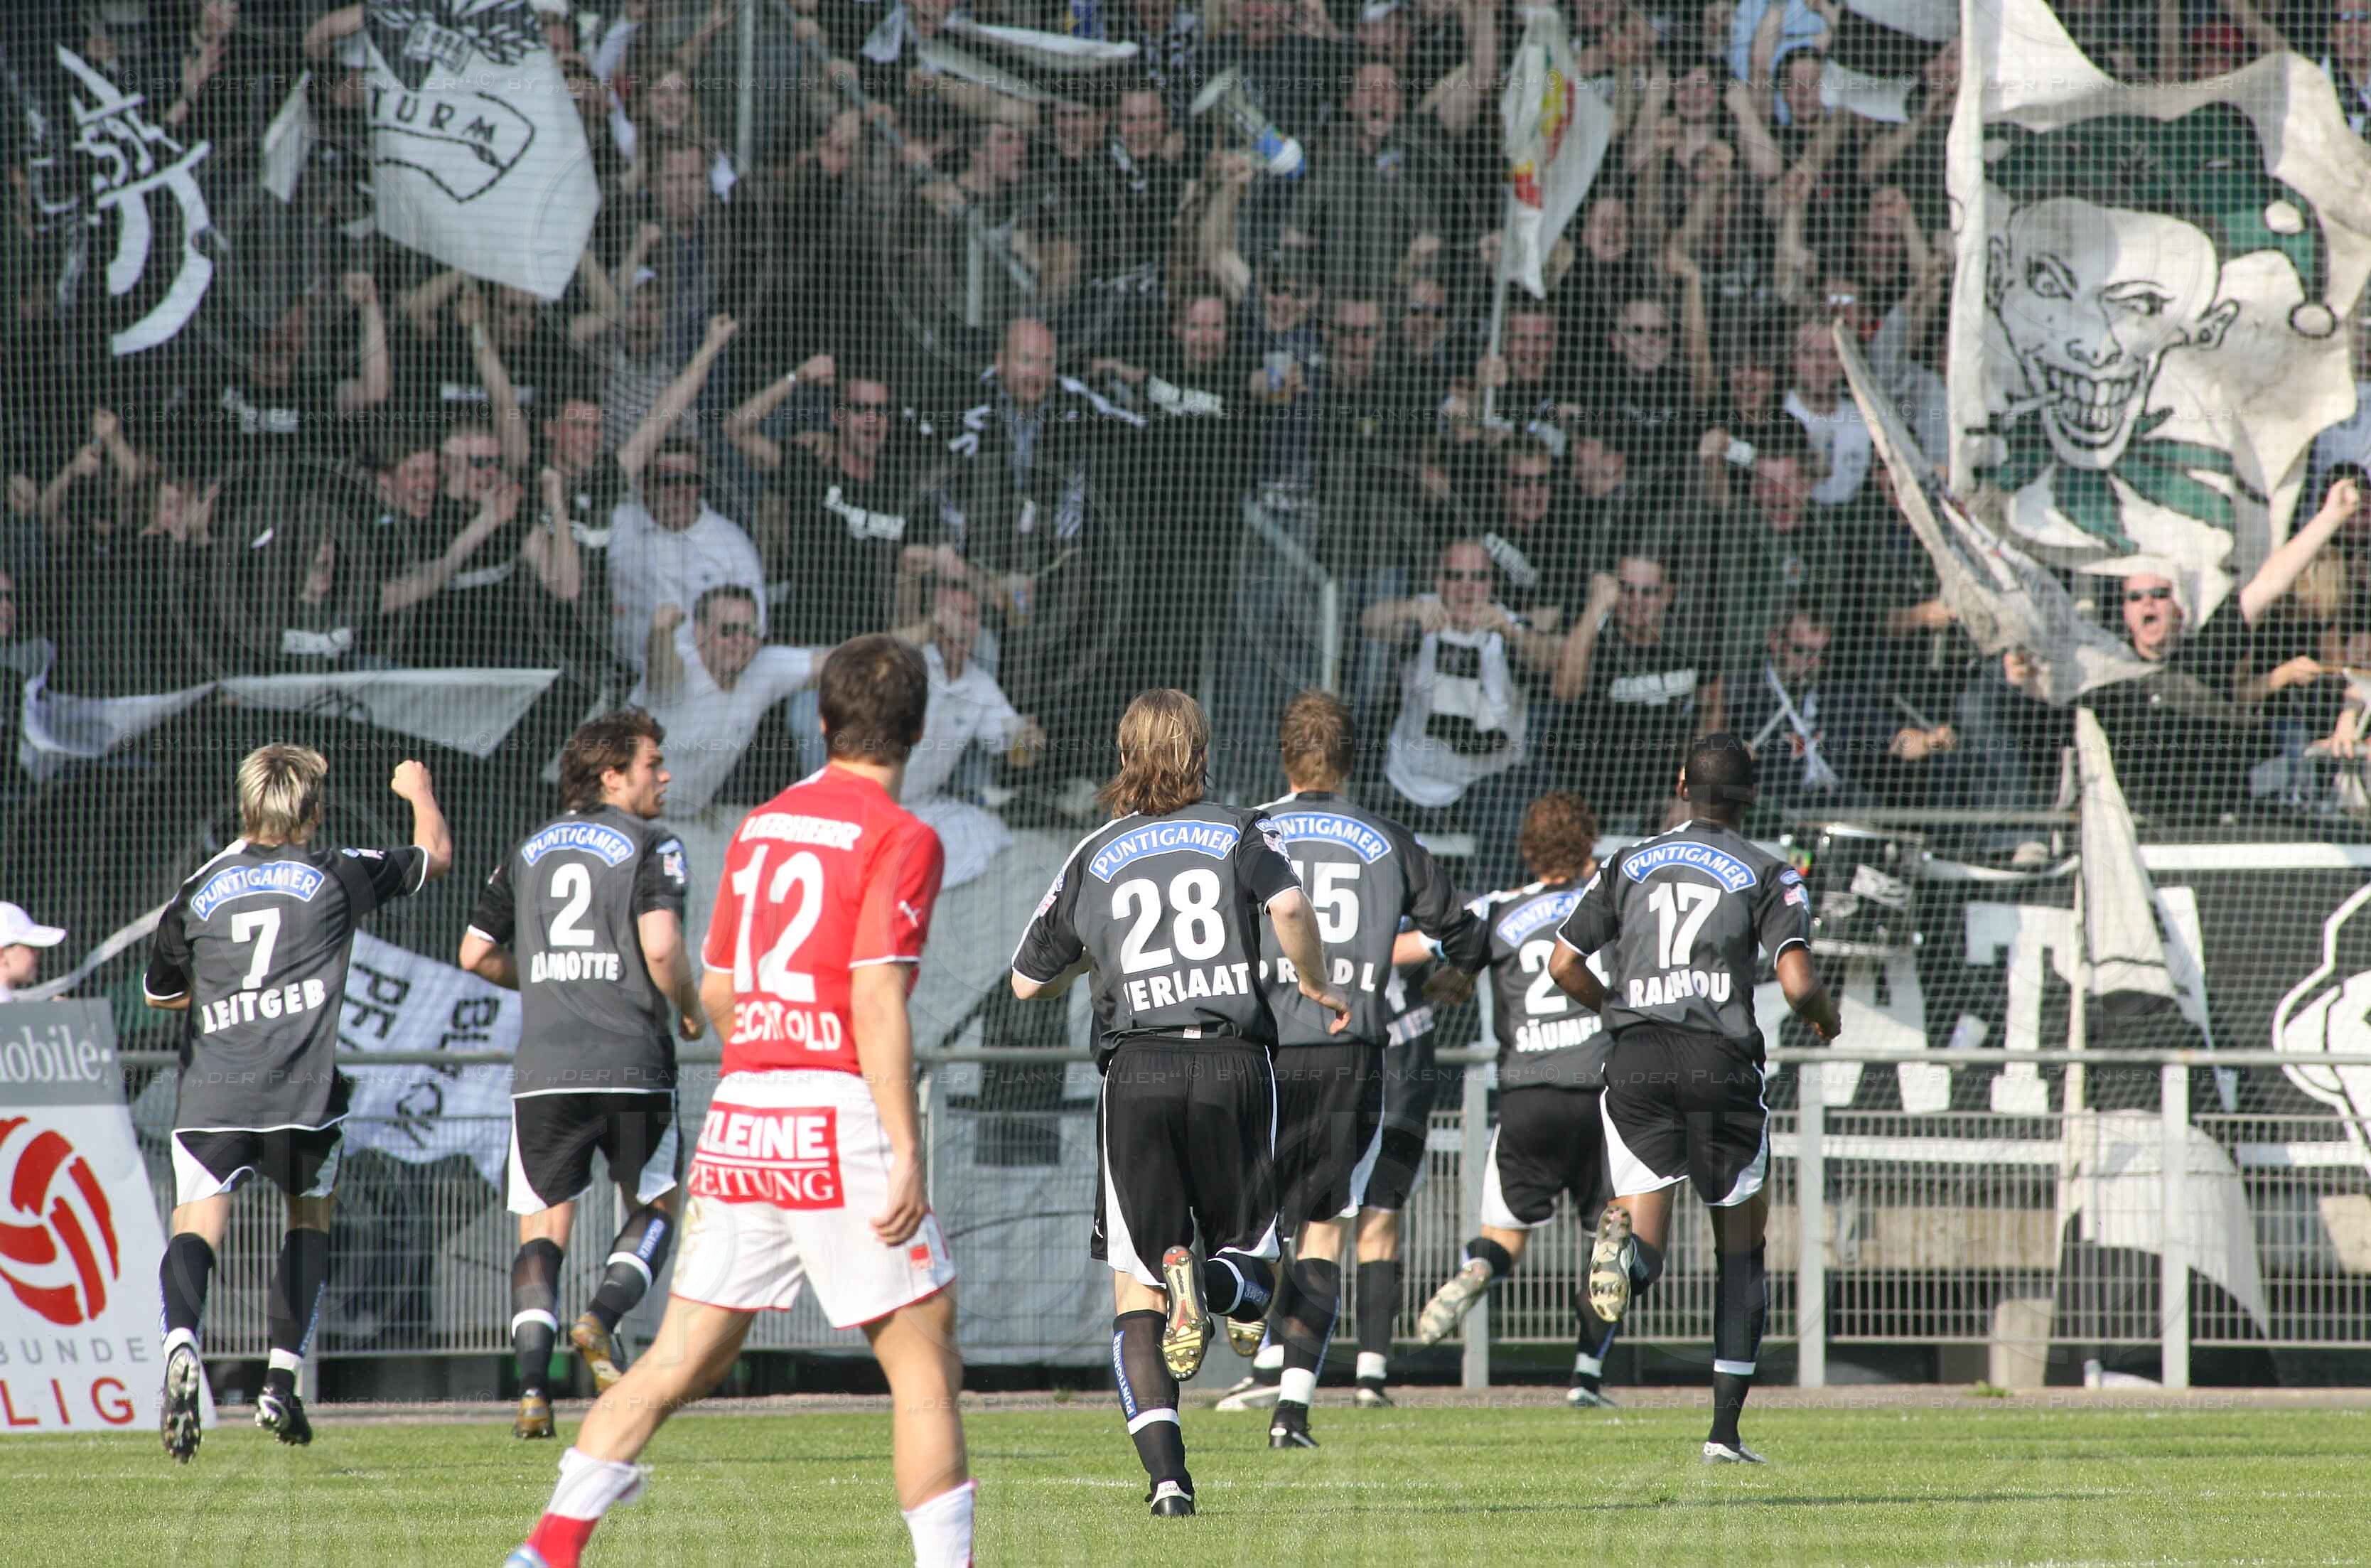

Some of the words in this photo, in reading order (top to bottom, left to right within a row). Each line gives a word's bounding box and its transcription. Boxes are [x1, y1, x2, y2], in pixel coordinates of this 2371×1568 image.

[525, 827, 628, 863] PUNTIGAMER
[1094, 827, 1232, 875] PUNTIGAMER
[1274, 817, 1383, 858] NTIGAMER
[1626, 846, 1748, 888] PUNTIGAMER
[195, 868, 317, 912] PUNTIGAMER
[549, 863, 595, 947] 2
[1111, 869, 1226, 974] 28
[1290, 860, 1360, 944] 5
[1502, 892, 1582, 940] PUNTIGA
[231, 907, 281, 990] 7
[732, 844, 824, 1003] 12
[1649, 882, 1721, 969] 17
[201, 978, 326, 1033] LEITGEB
[1259, 957, 1376, 992] RDL
[1520, 939, 1611, 1015] 2
[1112, 1333, 1135, 1417] PUNTIGAMER
